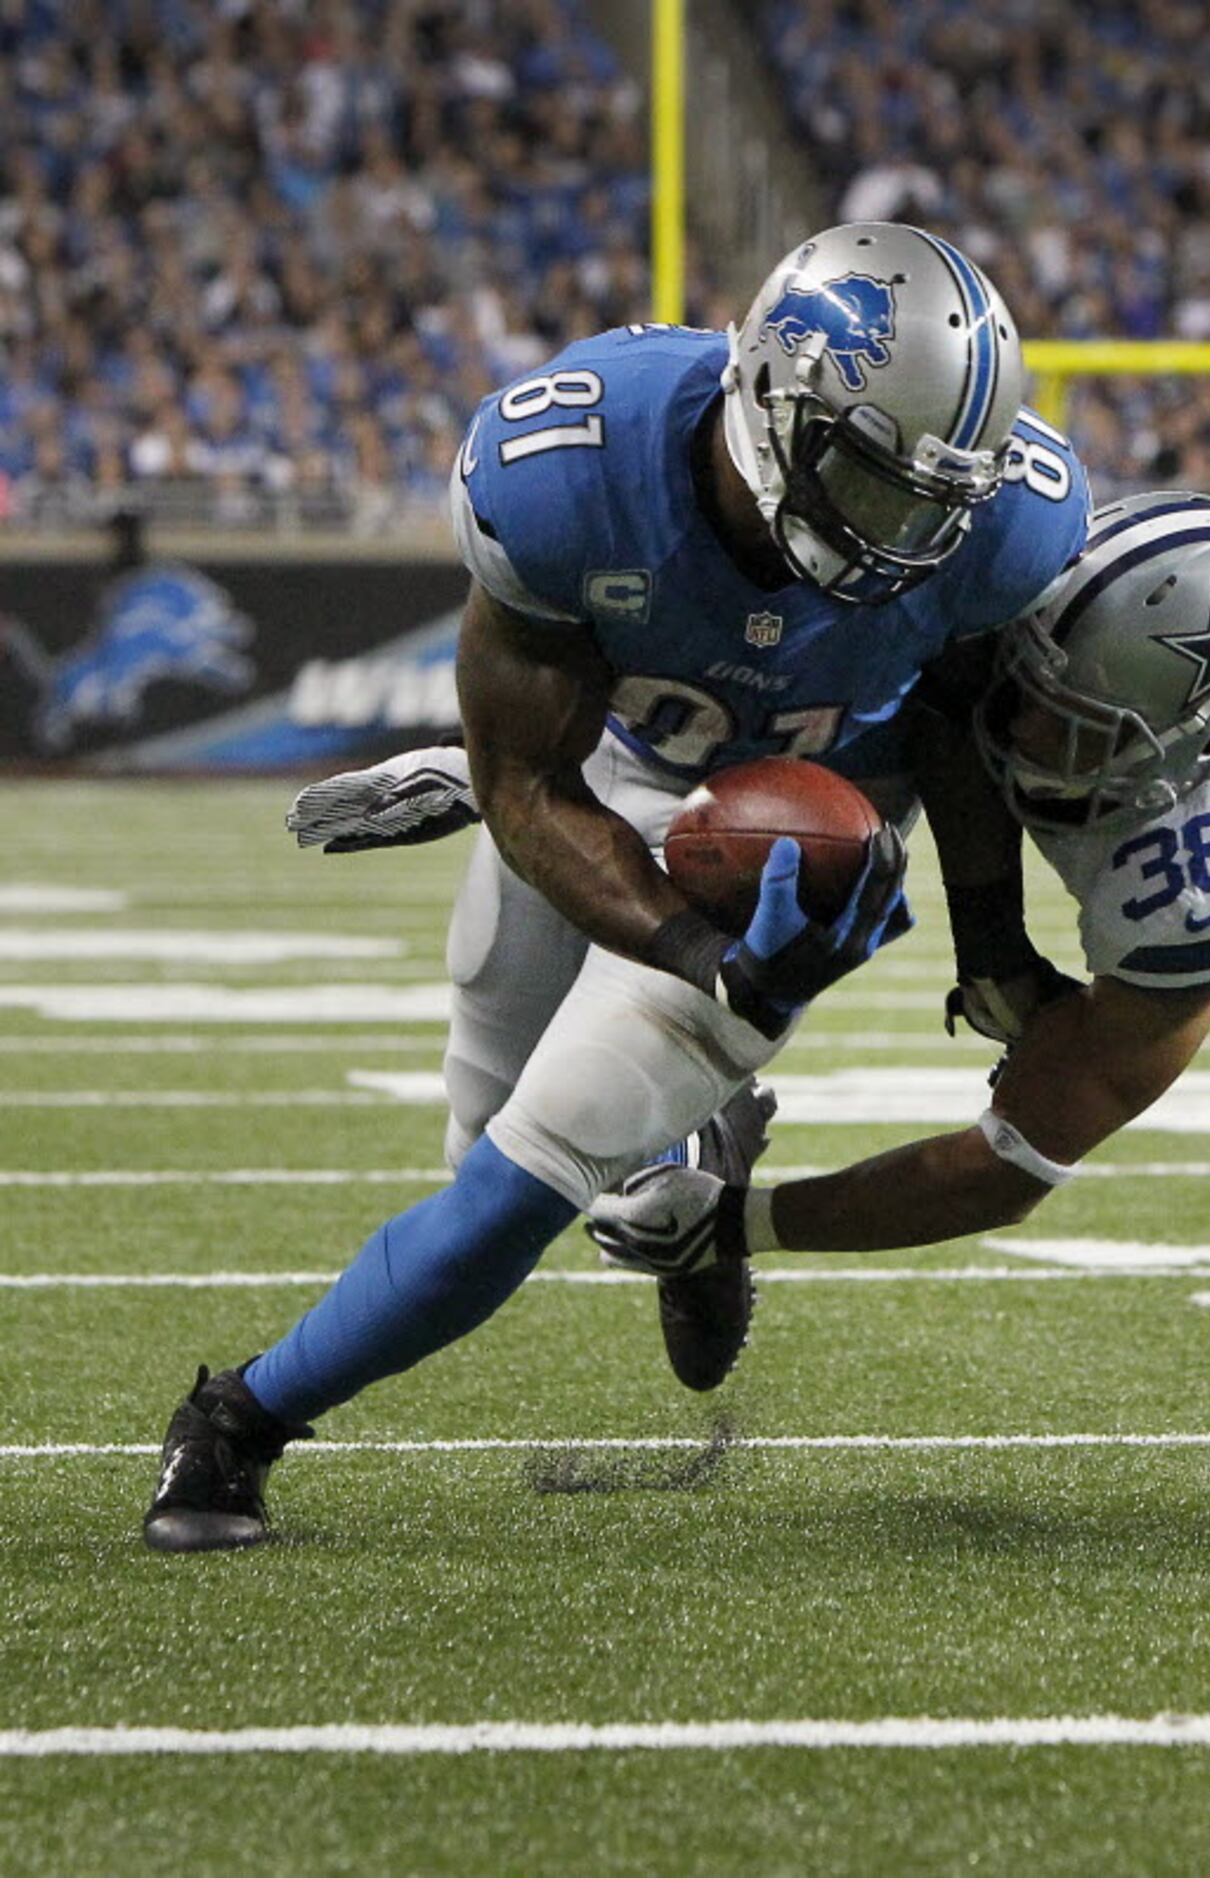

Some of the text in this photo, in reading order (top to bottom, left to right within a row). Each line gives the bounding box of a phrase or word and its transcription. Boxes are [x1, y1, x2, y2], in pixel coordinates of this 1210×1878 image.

[500, 369, 605, 467] 81
[588, 573, 648, 611] C
[704, 660, 795, 692] LIONS
